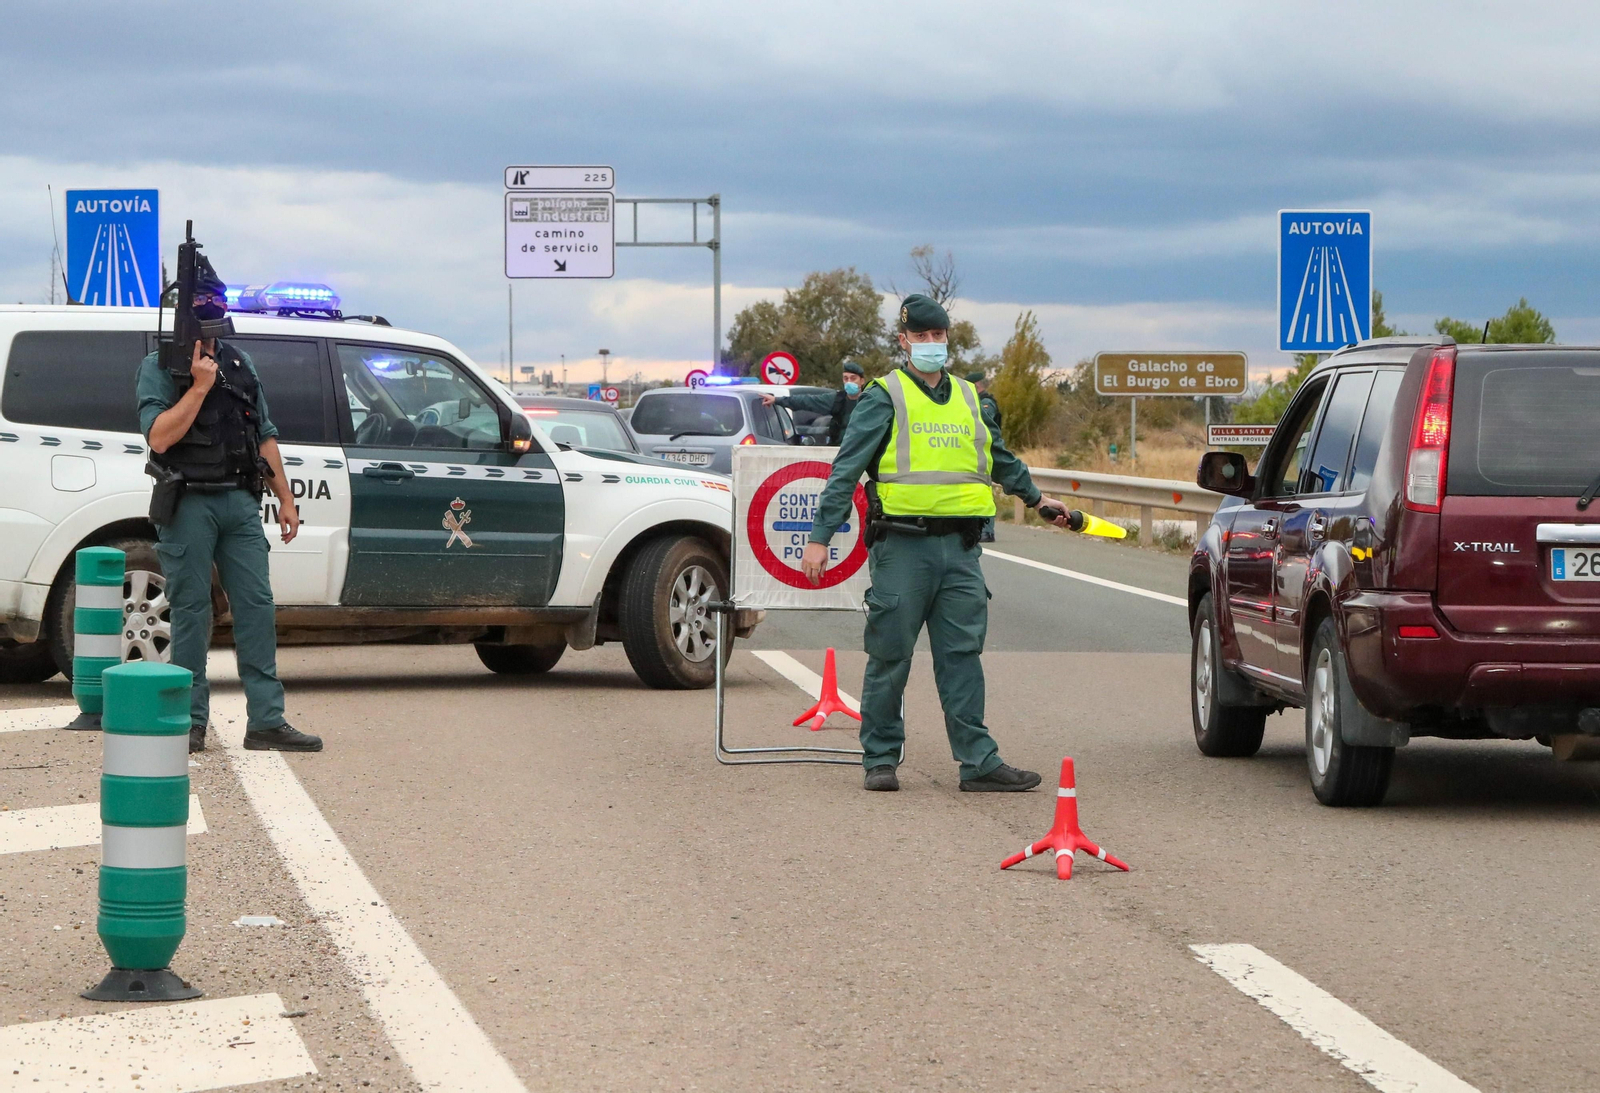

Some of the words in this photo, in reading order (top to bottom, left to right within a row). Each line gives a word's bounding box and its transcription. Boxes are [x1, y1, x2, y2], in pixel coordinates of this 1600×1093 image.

[584, 173, 607, 182] 225
[74, 195, 151, 213] AUTOVÍA
[535, 228, 584, 238] camino
[1288, 218, 1363, 235] AUTOVÍA
[521, 243, 536, 253] de
[544, 243, 599, 253] servicio
[1128, 359, 1188, 373] Galacho
[1196, 361, 1215, 373] de
[691, 377, 705, 387] 80
[1103, 375, 1118, 387] El
[1126, 375, 1170, 390] Burgo
[1179, 376, 1197, 387] de
[1205, 375, 1239, 388] Ebro
[911, 422, 971, 437] GUARDIA
[928, 436, 962, 449] CIVIL
[625, 475, 671, 485] GUARDIA
[673, 478, 698, 487] CIVIL
[779, 493, 819, 507] CONT
[784, 546, 839, 560] POE
[1453, 541, 1520, 553] X-TRAIL
[1556, 567, 1563, 575] E
